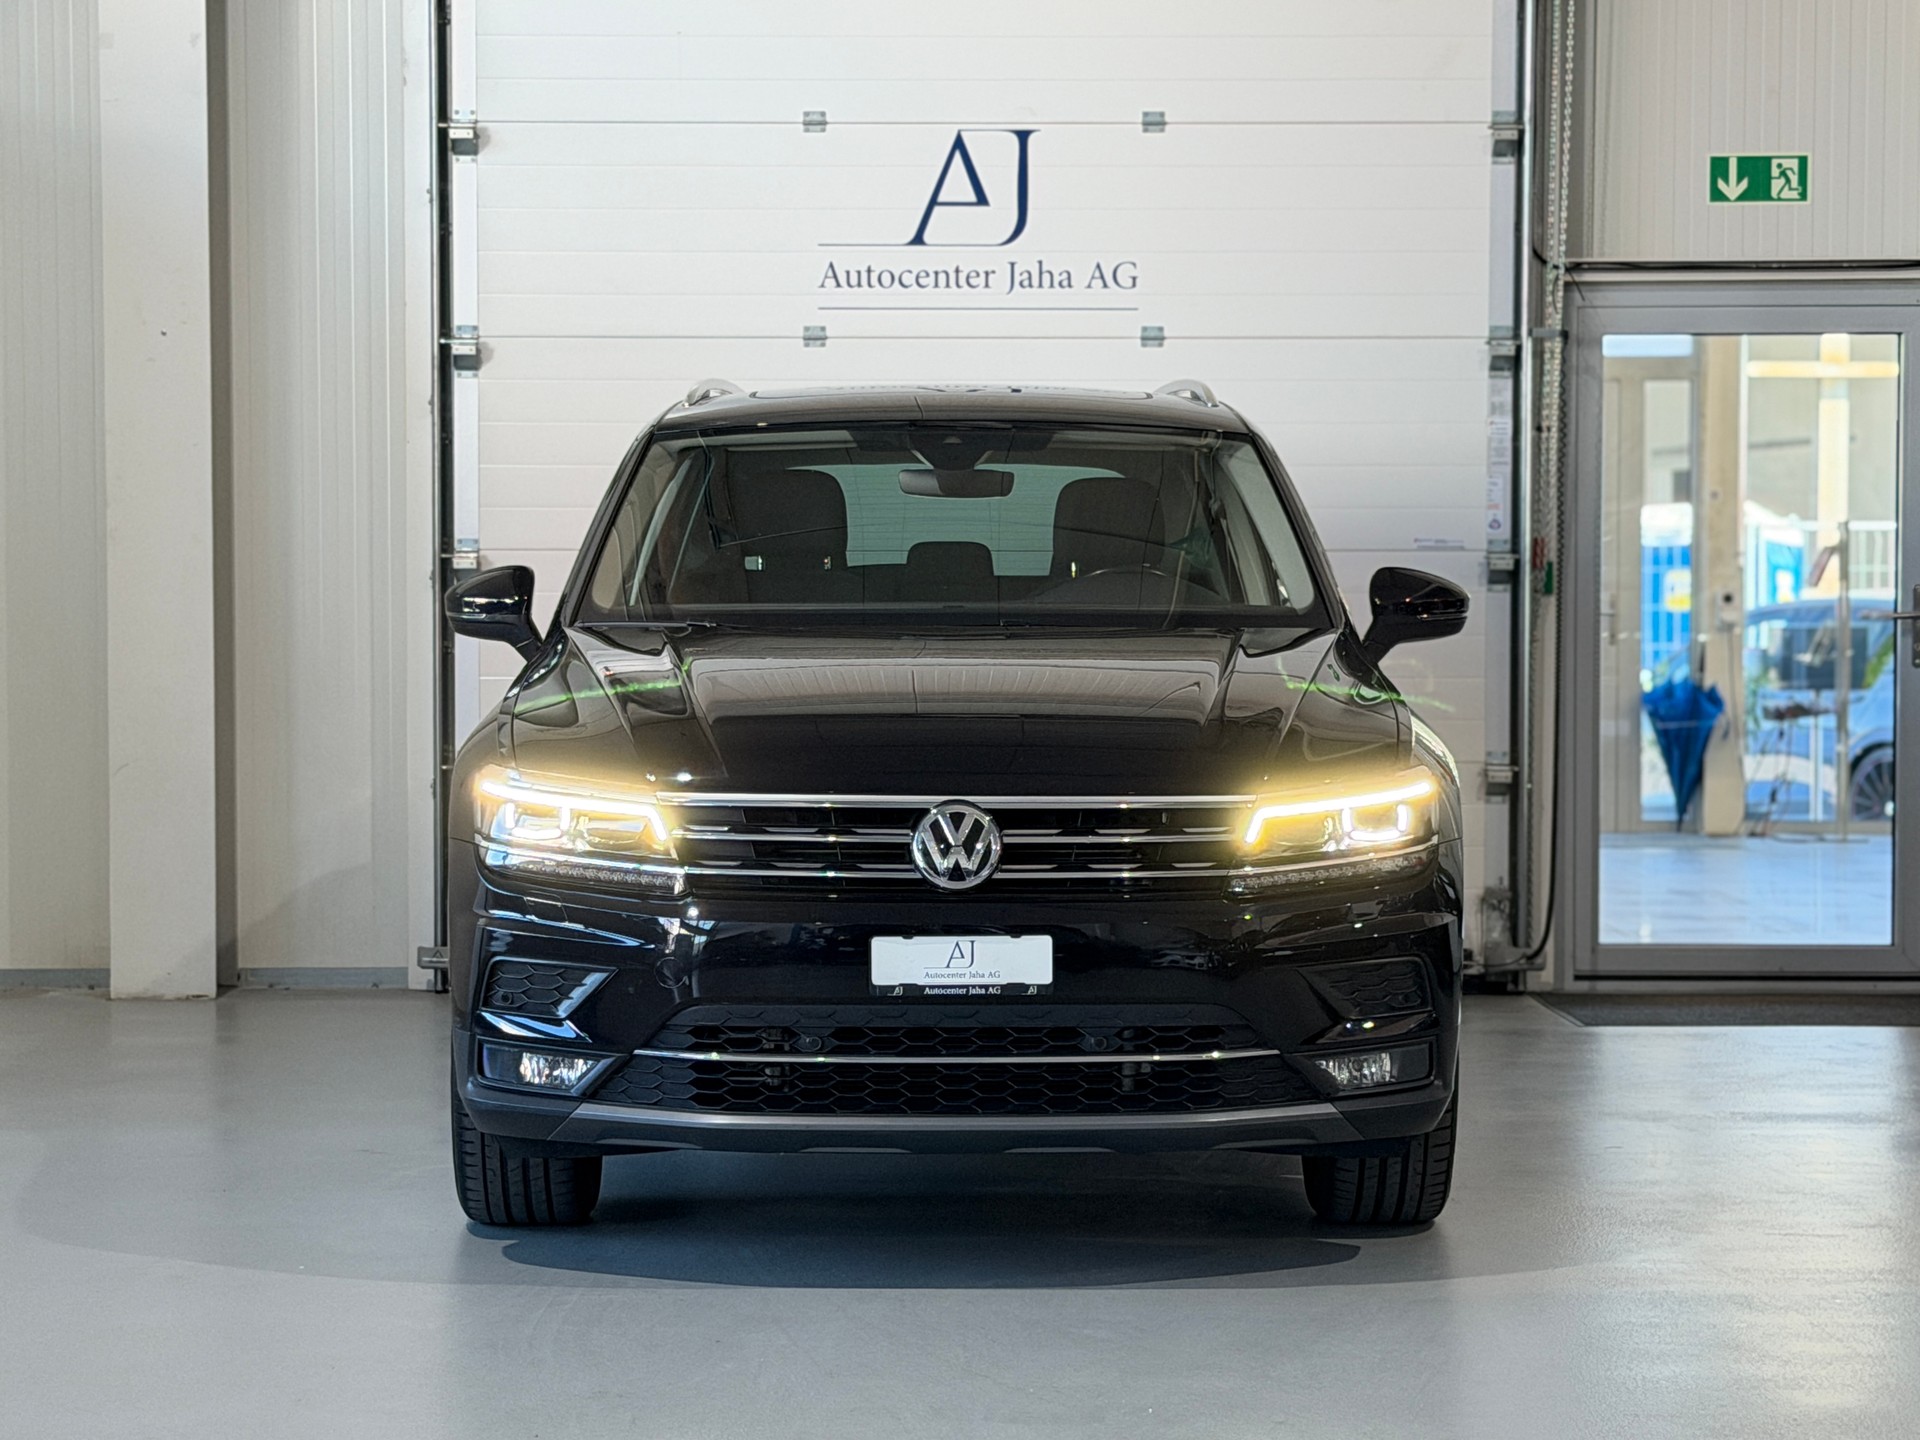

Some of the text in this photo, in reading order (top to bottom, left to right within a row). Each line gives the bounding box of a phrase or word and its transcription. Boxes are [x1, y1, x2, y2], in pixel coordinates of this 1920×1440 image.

[906, 129, 1040, 247] AJ
[818, 260, 1139, 295] Autocenter Jaha AG
[945, 940, 976, 968] AJ
[923, 971, 1001, 980] Autocenter Jaha AG
[923, 986, 1001, 996] Autocenter Jaha AG
